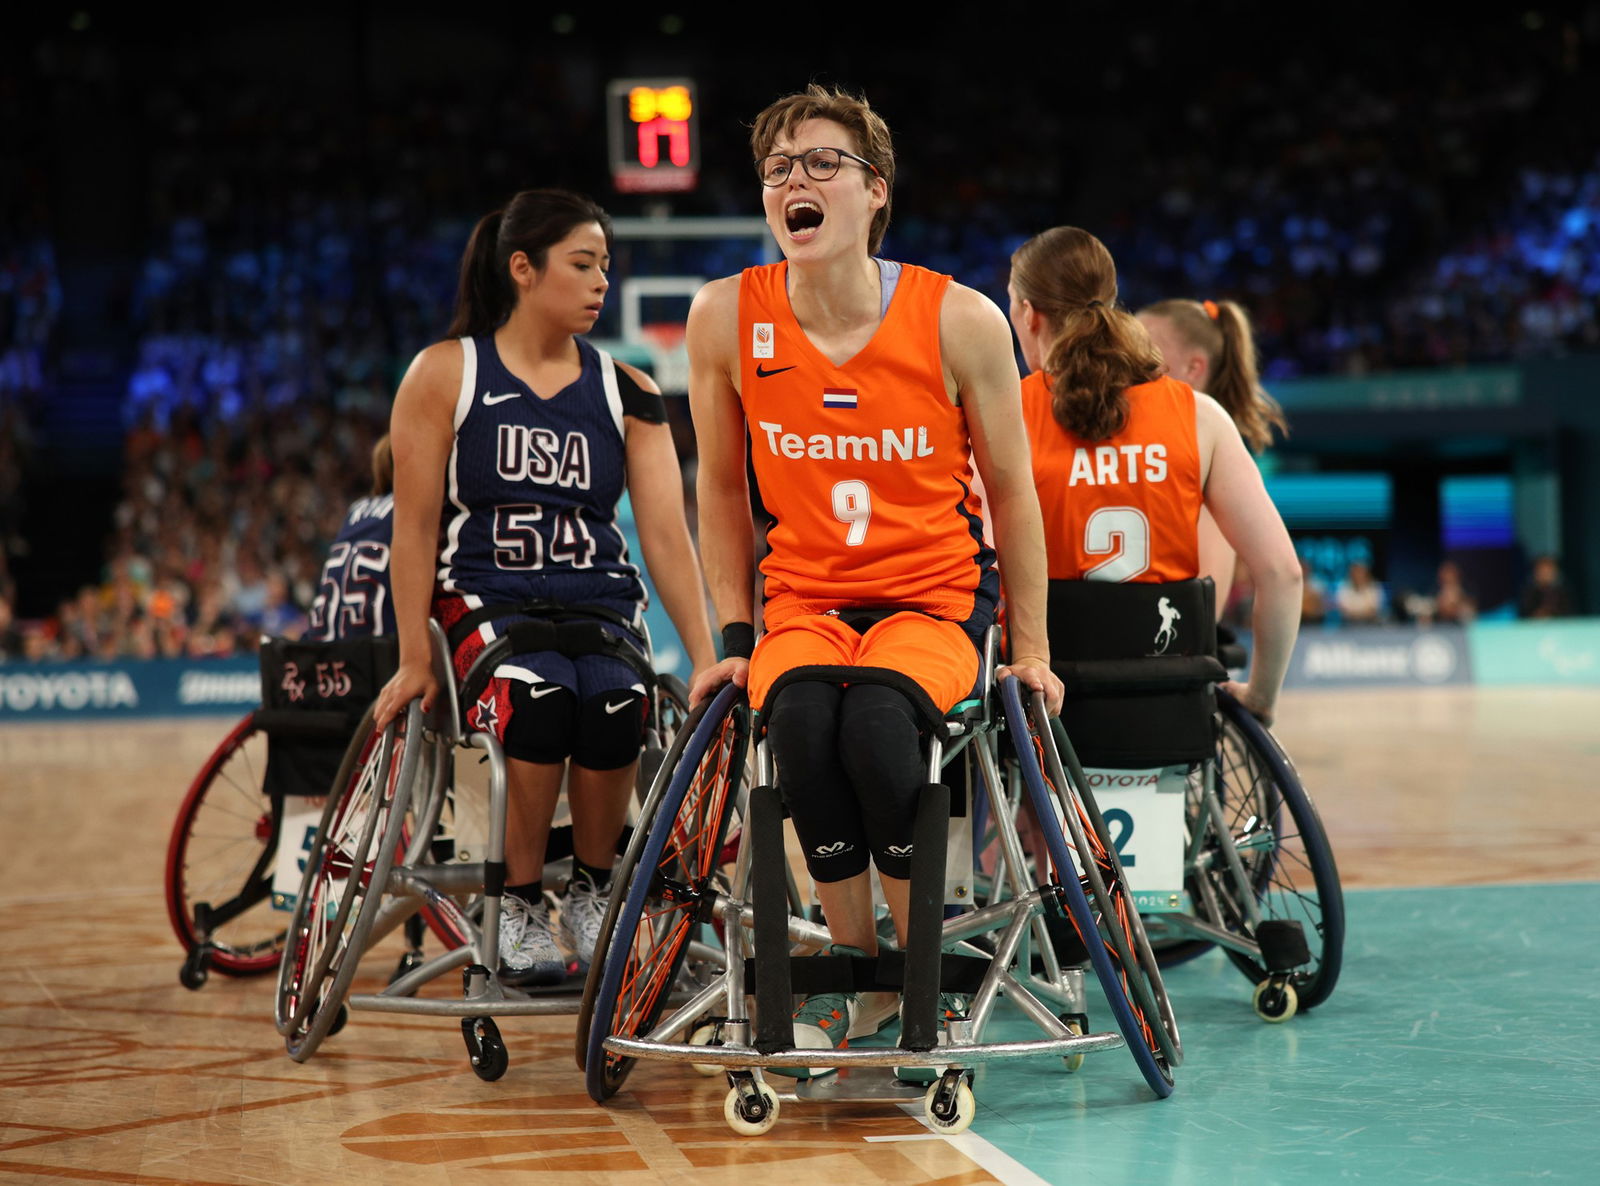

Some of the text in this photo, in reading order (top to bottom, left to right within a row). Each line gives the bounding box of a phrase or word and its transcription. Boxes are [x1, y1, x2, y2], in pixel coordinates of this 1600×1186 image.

[497, 424, 590, 491] USA
[759, 421, 934, 461] TeamNL
[1068, 444, 1167, 486] ARTS
[493, 504, 596, 570] 54
[831, 480, 871, 546] 9
[1084, 506, 1150, 583] 2
[309, 541, 390, 641] 55
[0, 672, 139, 711] OYOTA
[315, 661, 352, 698] 55
[1101, 808, 1135, 867] 2
